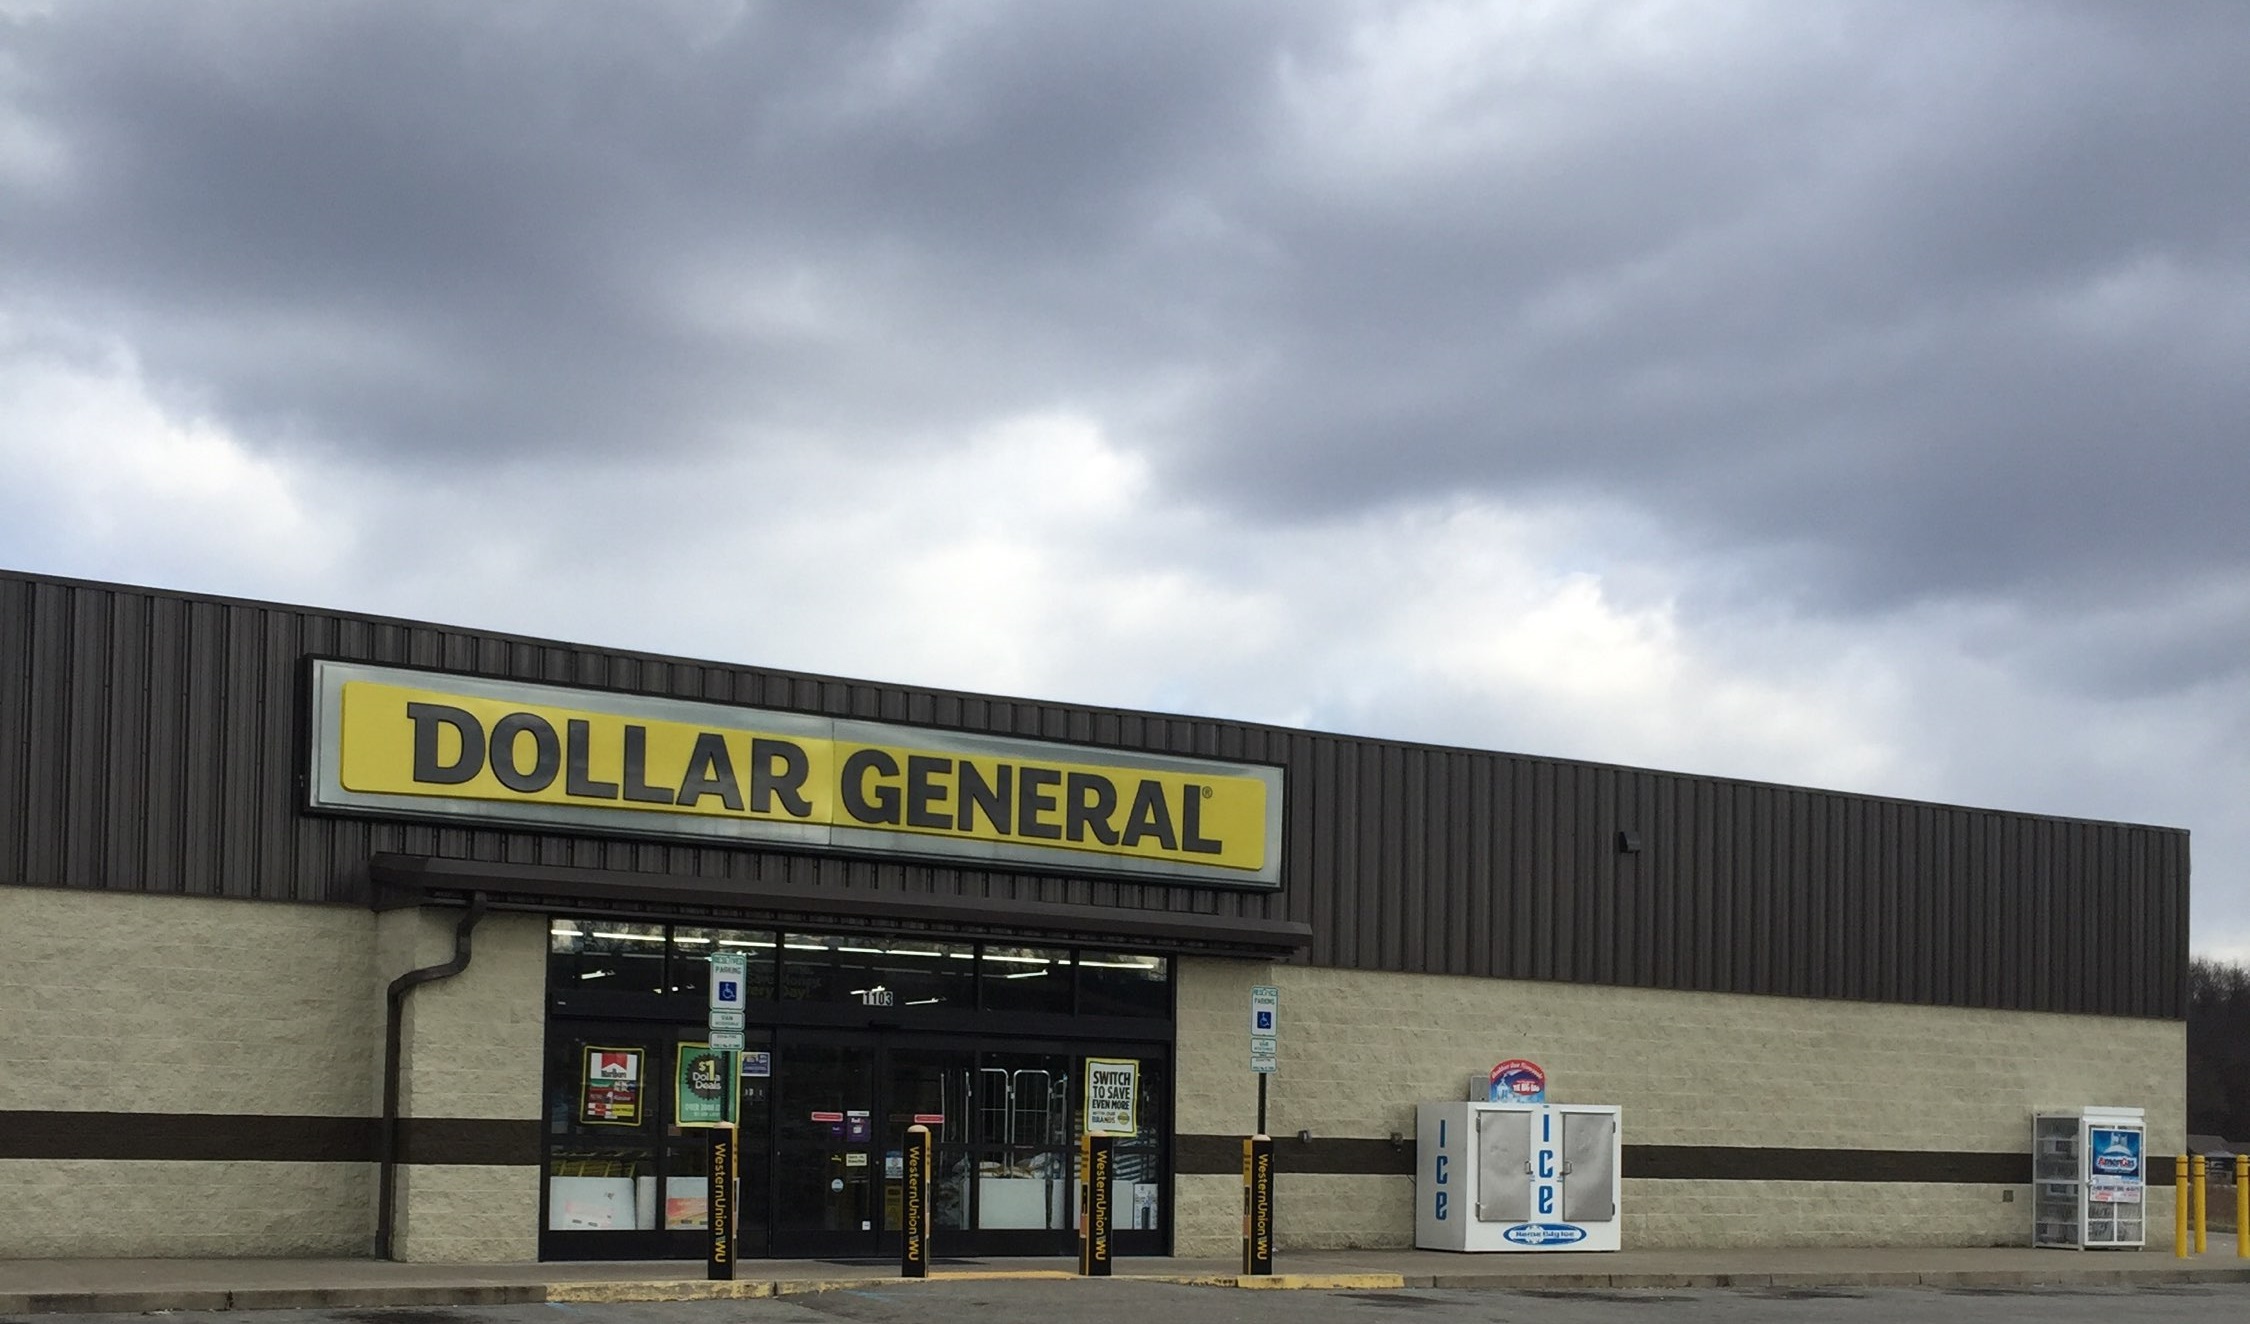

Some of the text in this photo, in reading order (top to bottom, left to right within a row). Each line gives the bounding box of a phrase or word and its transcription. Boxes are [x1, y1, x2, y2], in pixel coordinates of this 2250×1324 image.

[407, 702, 812, 818] DOLLAR
[715, 966, 741, 975] PARKING
[864, 992, 893, 1005] 1103
[699, 1060, 715, 1081] $1
[1093, 1070, 1131, 1086] SWITCH
[1093, 1086, 1131, 1100] TO SAVE
[1092, 1099, 1130, 1110] EVEN MORE
